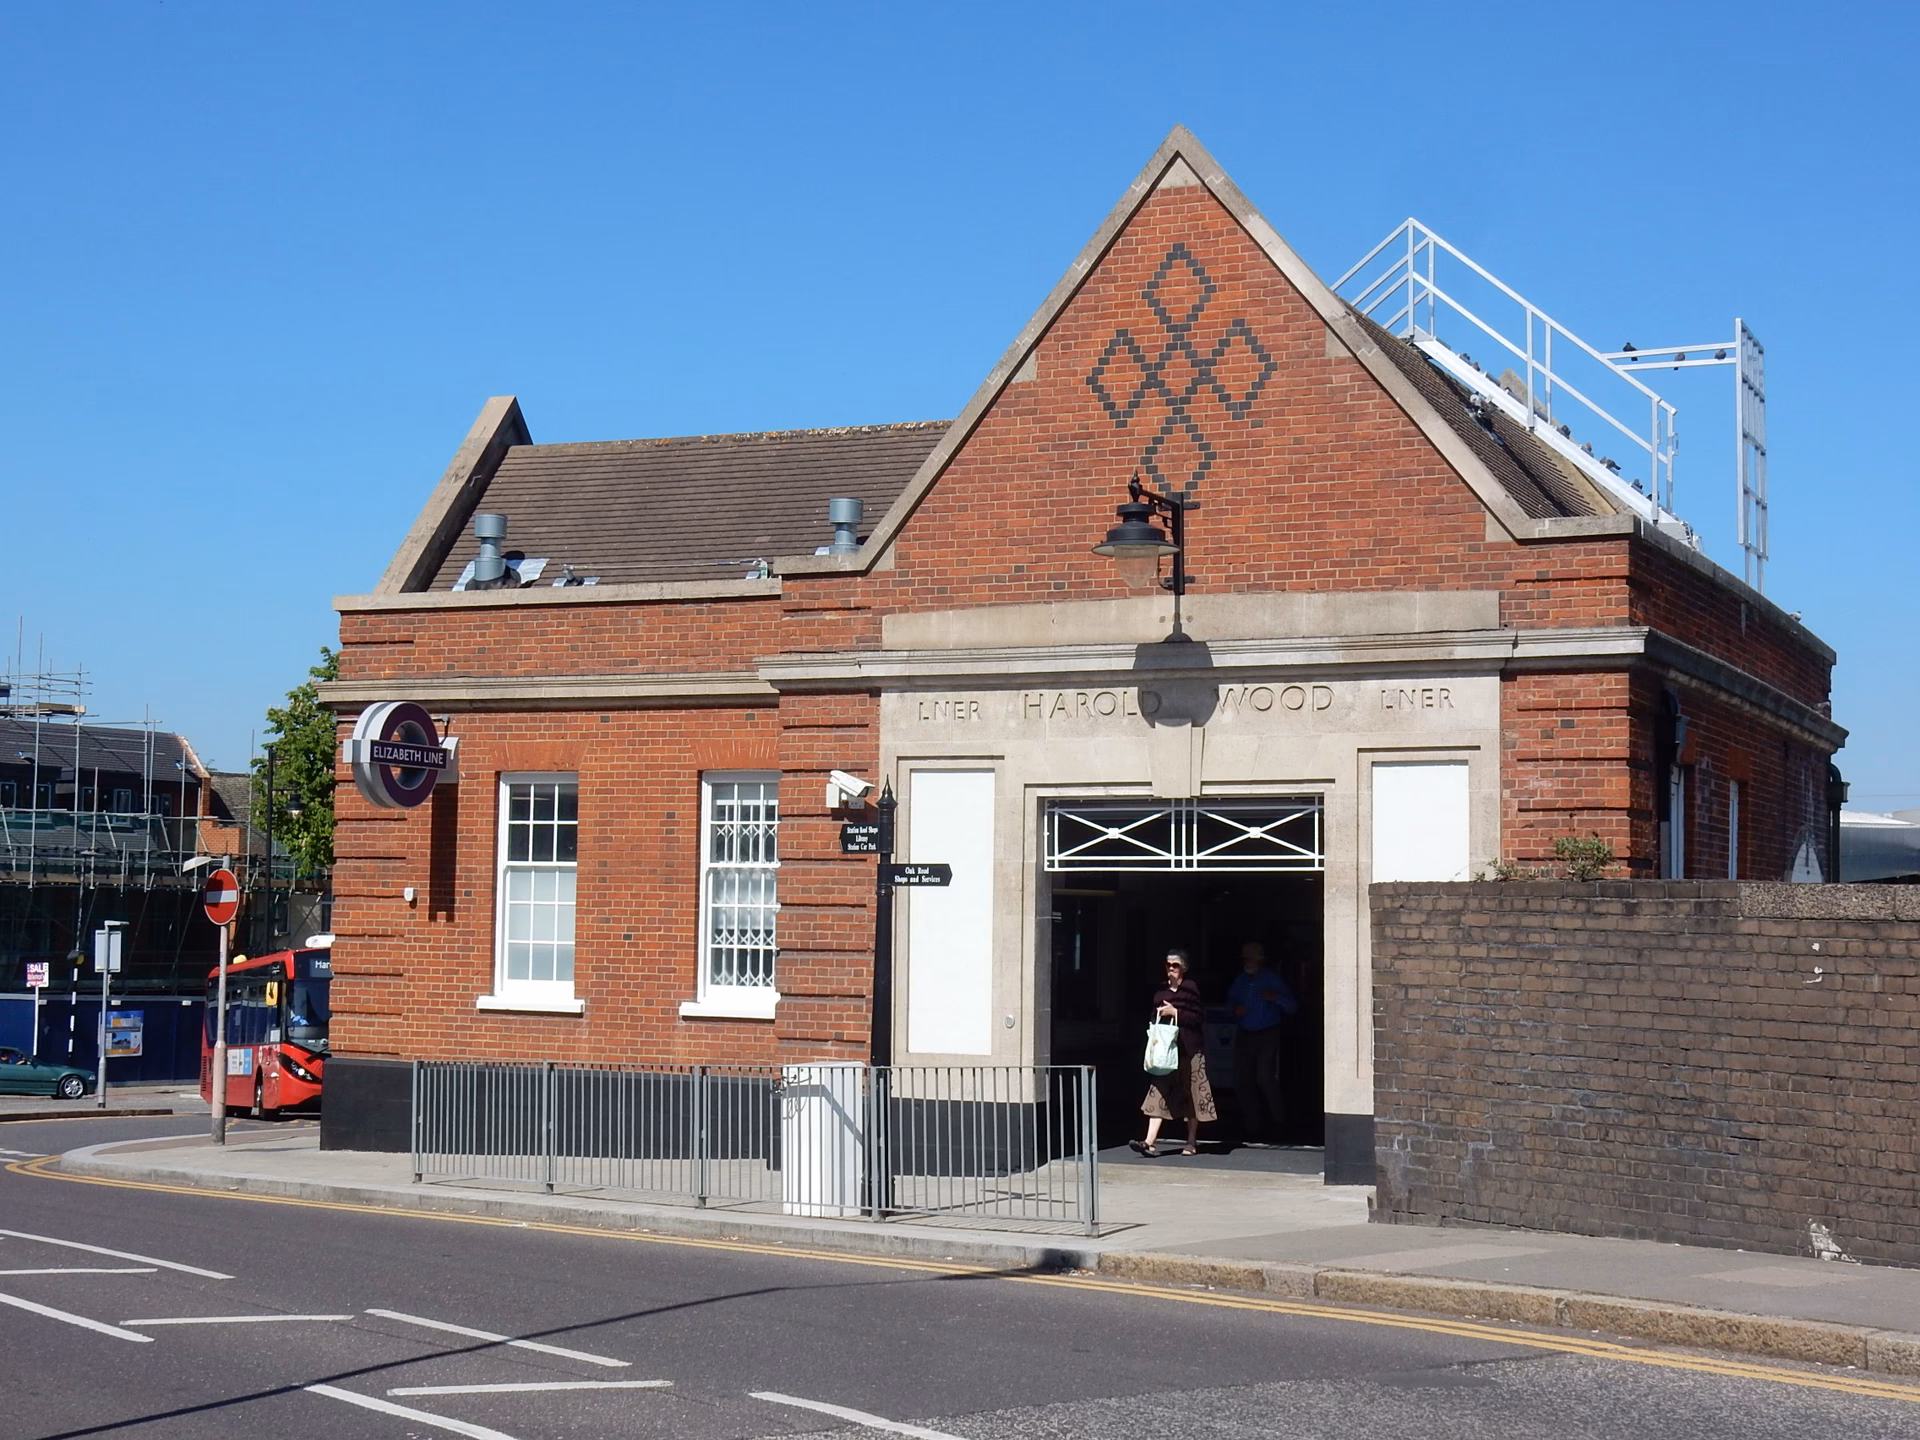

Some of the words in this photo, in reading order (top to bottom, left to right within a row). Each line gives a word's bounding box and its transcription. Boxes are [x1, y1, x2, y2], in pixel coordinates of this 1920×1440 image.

[1024, 690, 1163, 720] HAROLD
[1215, 684, 1336, 714] WOOD
[1380, 688, 1455, 710] LNER
[918, 700, 982, 721] LNER
[373, 745, 421, 762] ELIZABETH
[423, 751, 444, 765] LINE
[846, 826, 859, 834] Station
[904, 867, 915, 875] Oak
[918, 867, 929, 875] Road
[894, 875, 908, 884] Shops
[910, 875, 919, 883] and
[921, 875, 940, 883] Services
[315, 959, 331, 970] Har
